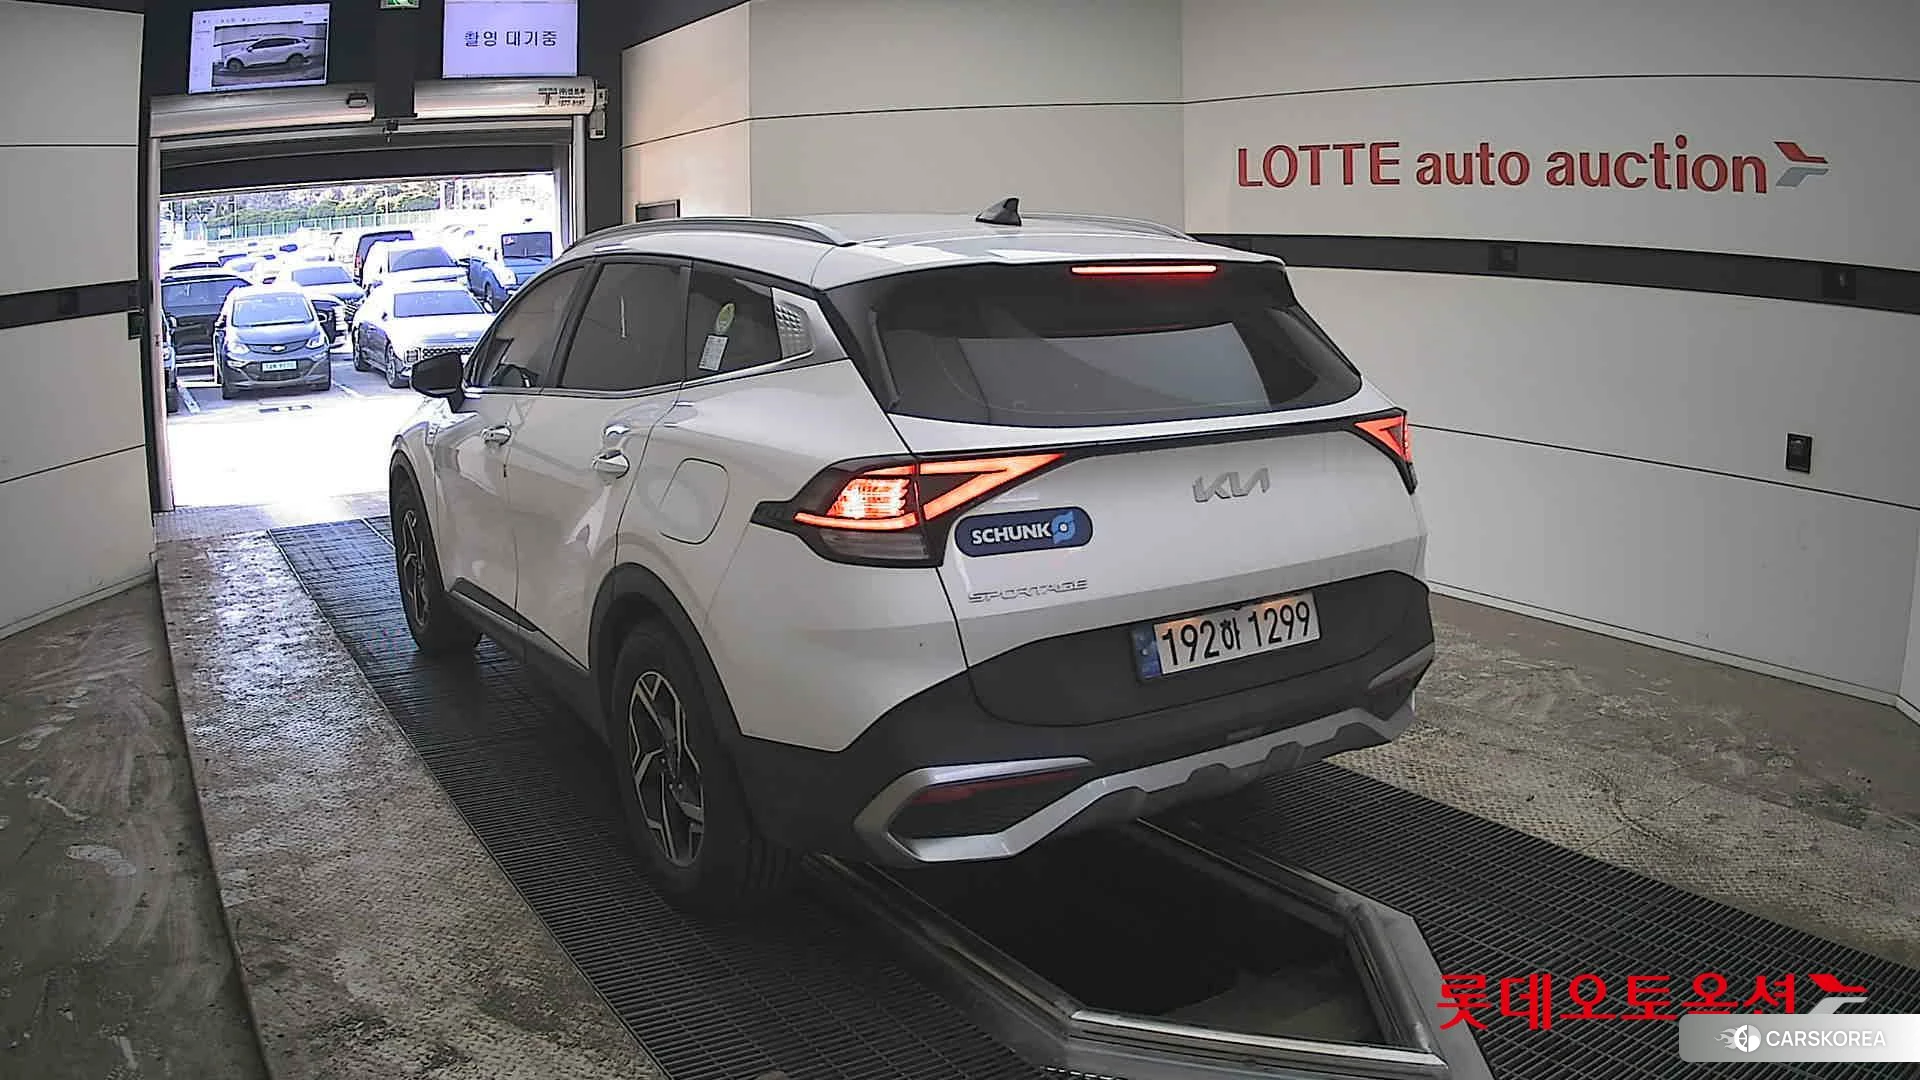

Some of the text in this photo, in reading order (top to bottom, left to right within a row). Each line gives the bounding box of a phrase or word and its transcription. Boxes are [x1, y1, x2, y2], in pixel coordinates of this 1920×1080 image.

[505, 30, 558, 47] 대기중
[1237, 135, 1768, 194] LOTTE auto auction
[1193, 467, 1270, 503] KIA
[971, 520, 1052, 545] SCHUNK
[967, 578, 1089, 604] SPORTAGE
[1162, 600, 1311, 666] 192하 1299
